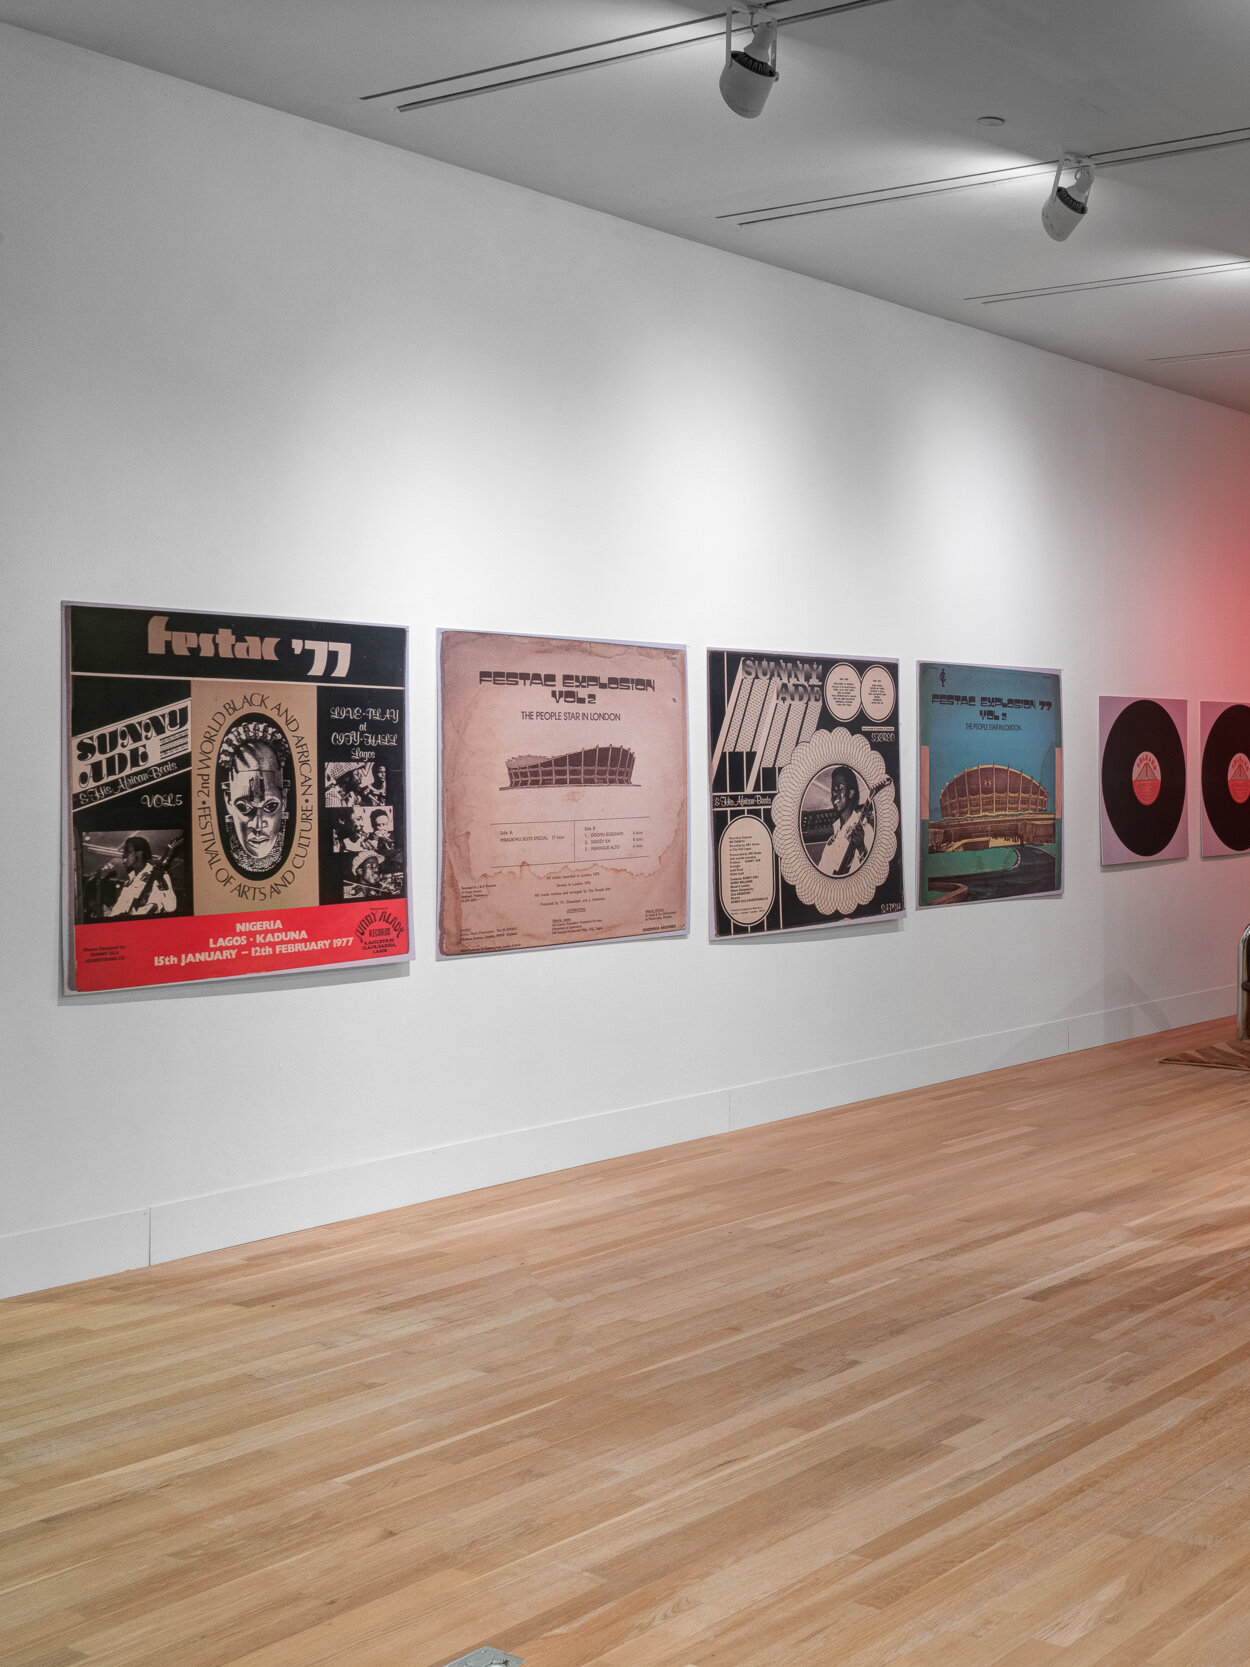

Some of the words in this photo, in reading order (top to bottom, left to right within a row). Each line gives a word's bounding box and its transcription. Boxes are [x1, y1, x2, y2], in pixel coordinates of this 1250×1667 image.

[148, 616, 281, 661] festac
[292, 639, 352, 678] '77
[479, 671, 556, 687] FESTAC
[563, 674, 656, 692] EXPLOSION
[742, 659, 823, 685] SUNNY
[223, 693, 270, 717] BLACK
[551, 690, 586, 704] VOL
[588, 694, 597, 704] 2
[777, 683, 823, 704] ADE
[932, 694, 976, 707] FESTAC
[981, 696, 1036, 710] EXPLOSION
[270, 702, 300, 733] AND
[359, 722, 367, 732] at
[521, 711, 535, 720] THE
[536, 711, 562, 721] PEOPLE
[564, 712, 581, 721] STAR
[582, 712, 589, 721] IN
[590, 712, 621, 722] LONDON
[979, 710, 1000, 721] VOL
[1002, 713, 1007, 721] 2
[77, 706, 189, 761] SUNNY
[1004, 724, 1022, 732] LONDON
[198, 712, 226, 771] WORLD
[79, 744, 149, 788] ADE
[292, 734, 313, 796] AFRICAN
[351, 747, 376, 762] Lagos
[113, 773, 150, 794] African
[148, 762, 178, 782] Beats
[197, 773, 210, 798] 2nd
[198, 806, 222, 870] FESTIVAL
[215, 868, 236, 888] OF
[230, 883, 267, 901] ARTS
[270, 870, 296, 899] AND
[292, 805, 314, 869] CULTURE
[236, 920, 283, 933] NIGERIA
[209, 936, 247, 948] LAGOS
[256, 930, 308, 944] KADUNA
[154, 955, 178, 967] 15th
[181, 949, 238, 967] JANUARY
[252, 947, 273, 957] 12th
[276, 940, 331, 955] FEBRUARY
[332, 937, 354, 948] 1977
